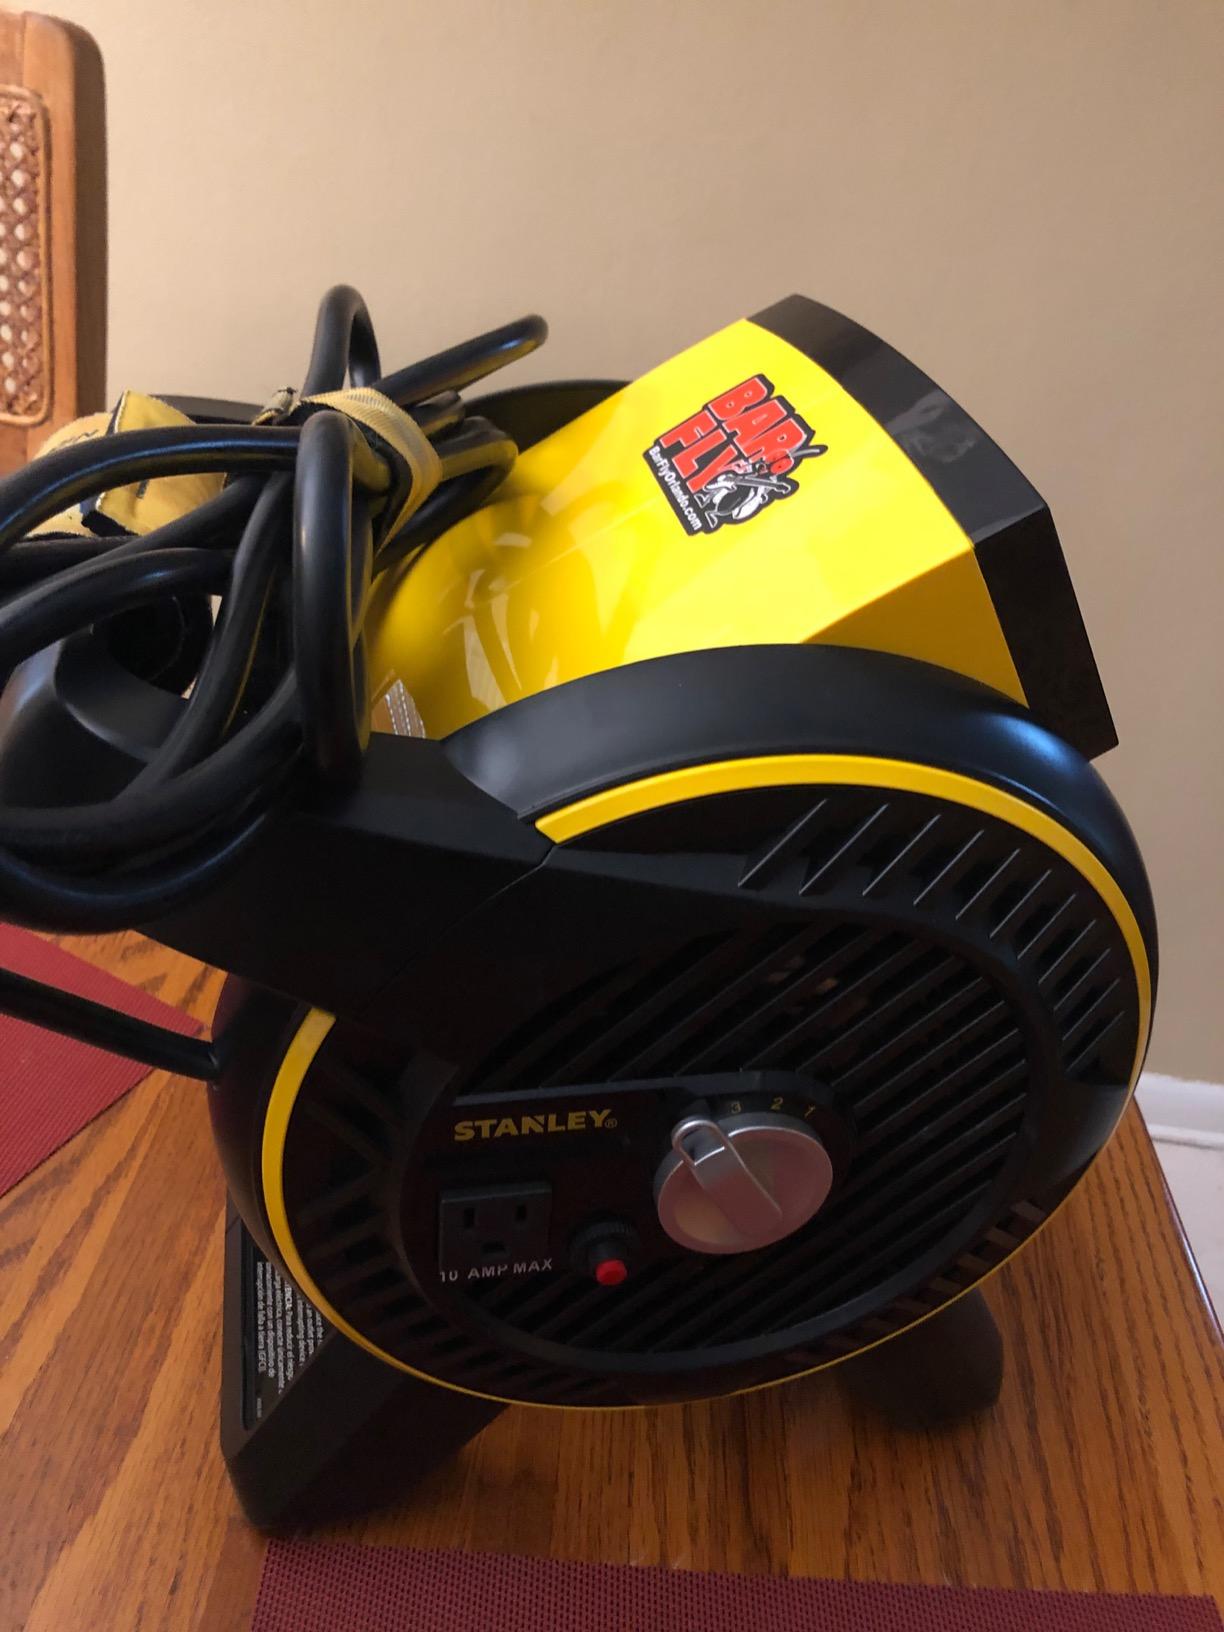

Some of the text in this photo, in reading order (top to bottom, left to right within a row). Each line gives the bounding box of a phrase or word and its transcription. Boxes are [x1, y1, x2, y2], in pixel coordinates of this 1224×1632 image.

[658, 410, 746, 494] FLY
[706, 376, 808, 464] BAR
[648, 446, 703, 531] BarFlyOrlando.com
[730, 1096, 817, 1119] 3 2 1
[467, 1264, 509, 1280] AMP
[513, 1258, 553, 1274] MAX
